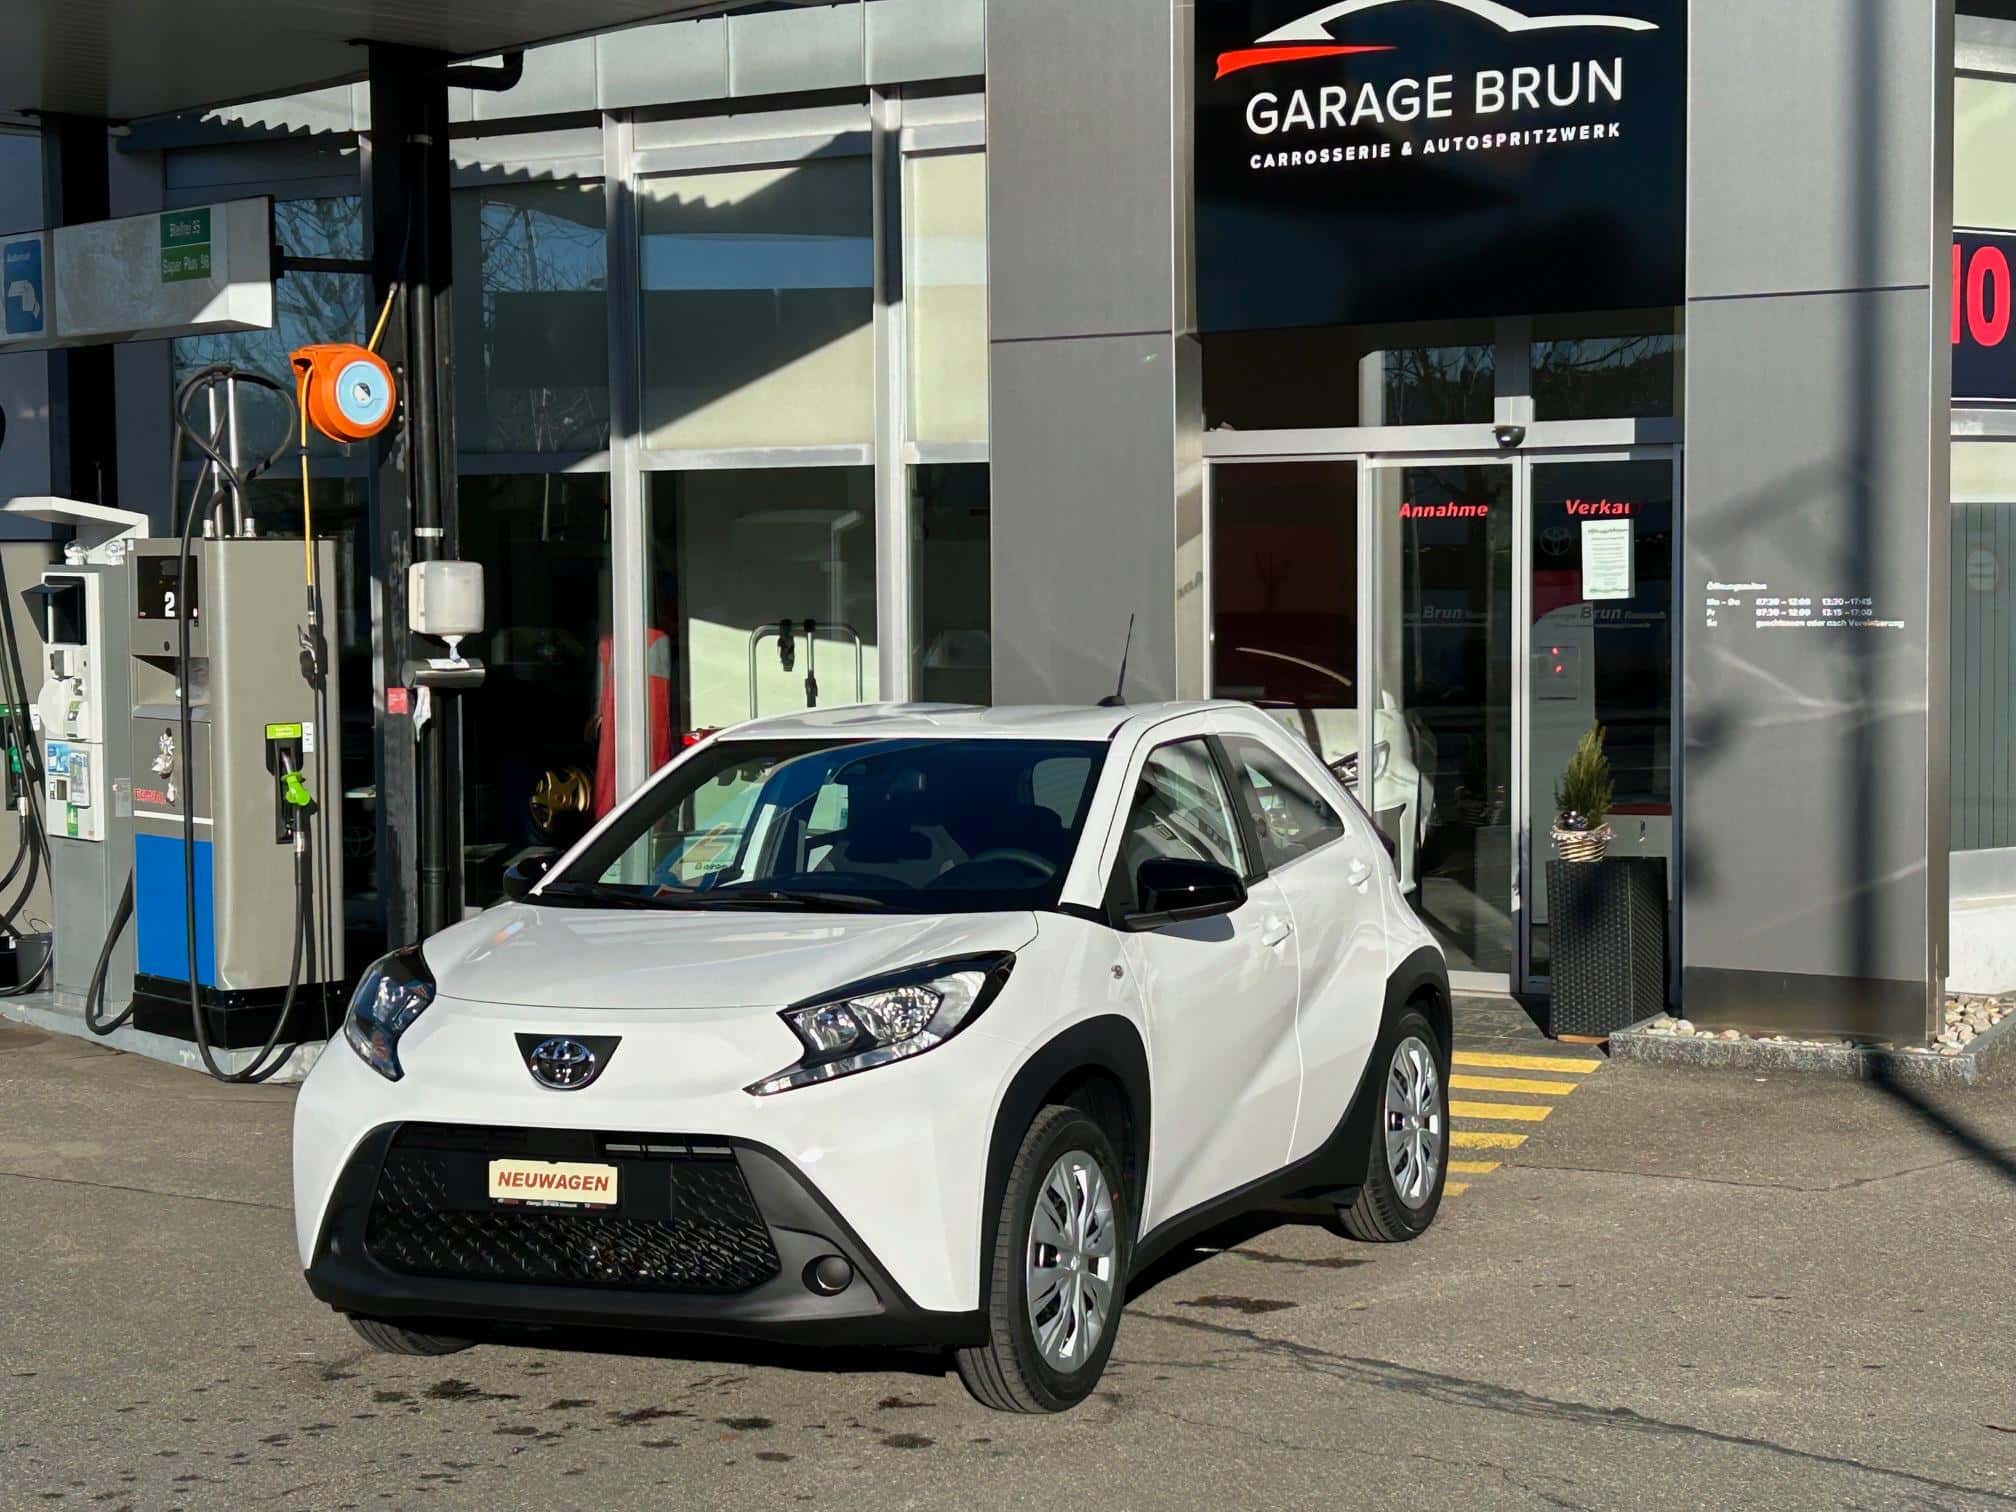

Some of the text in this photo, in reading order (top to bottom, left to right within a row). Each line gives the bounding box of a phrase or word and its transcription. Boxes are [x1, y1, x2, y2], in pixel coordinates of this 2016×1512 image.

[1246, 57, 1623, 135] GARAGE BRUN
[1250, 122, 1621, 169] CARROSSERIE & AUTOSPRITZWERK
[1398, 502, 1489, 518] Annahme
[1566, 498, 1641, 516] Verka
[164, 591, 176, 618] 2
[497, 1171, 610, 1192] NEUWAGEN
